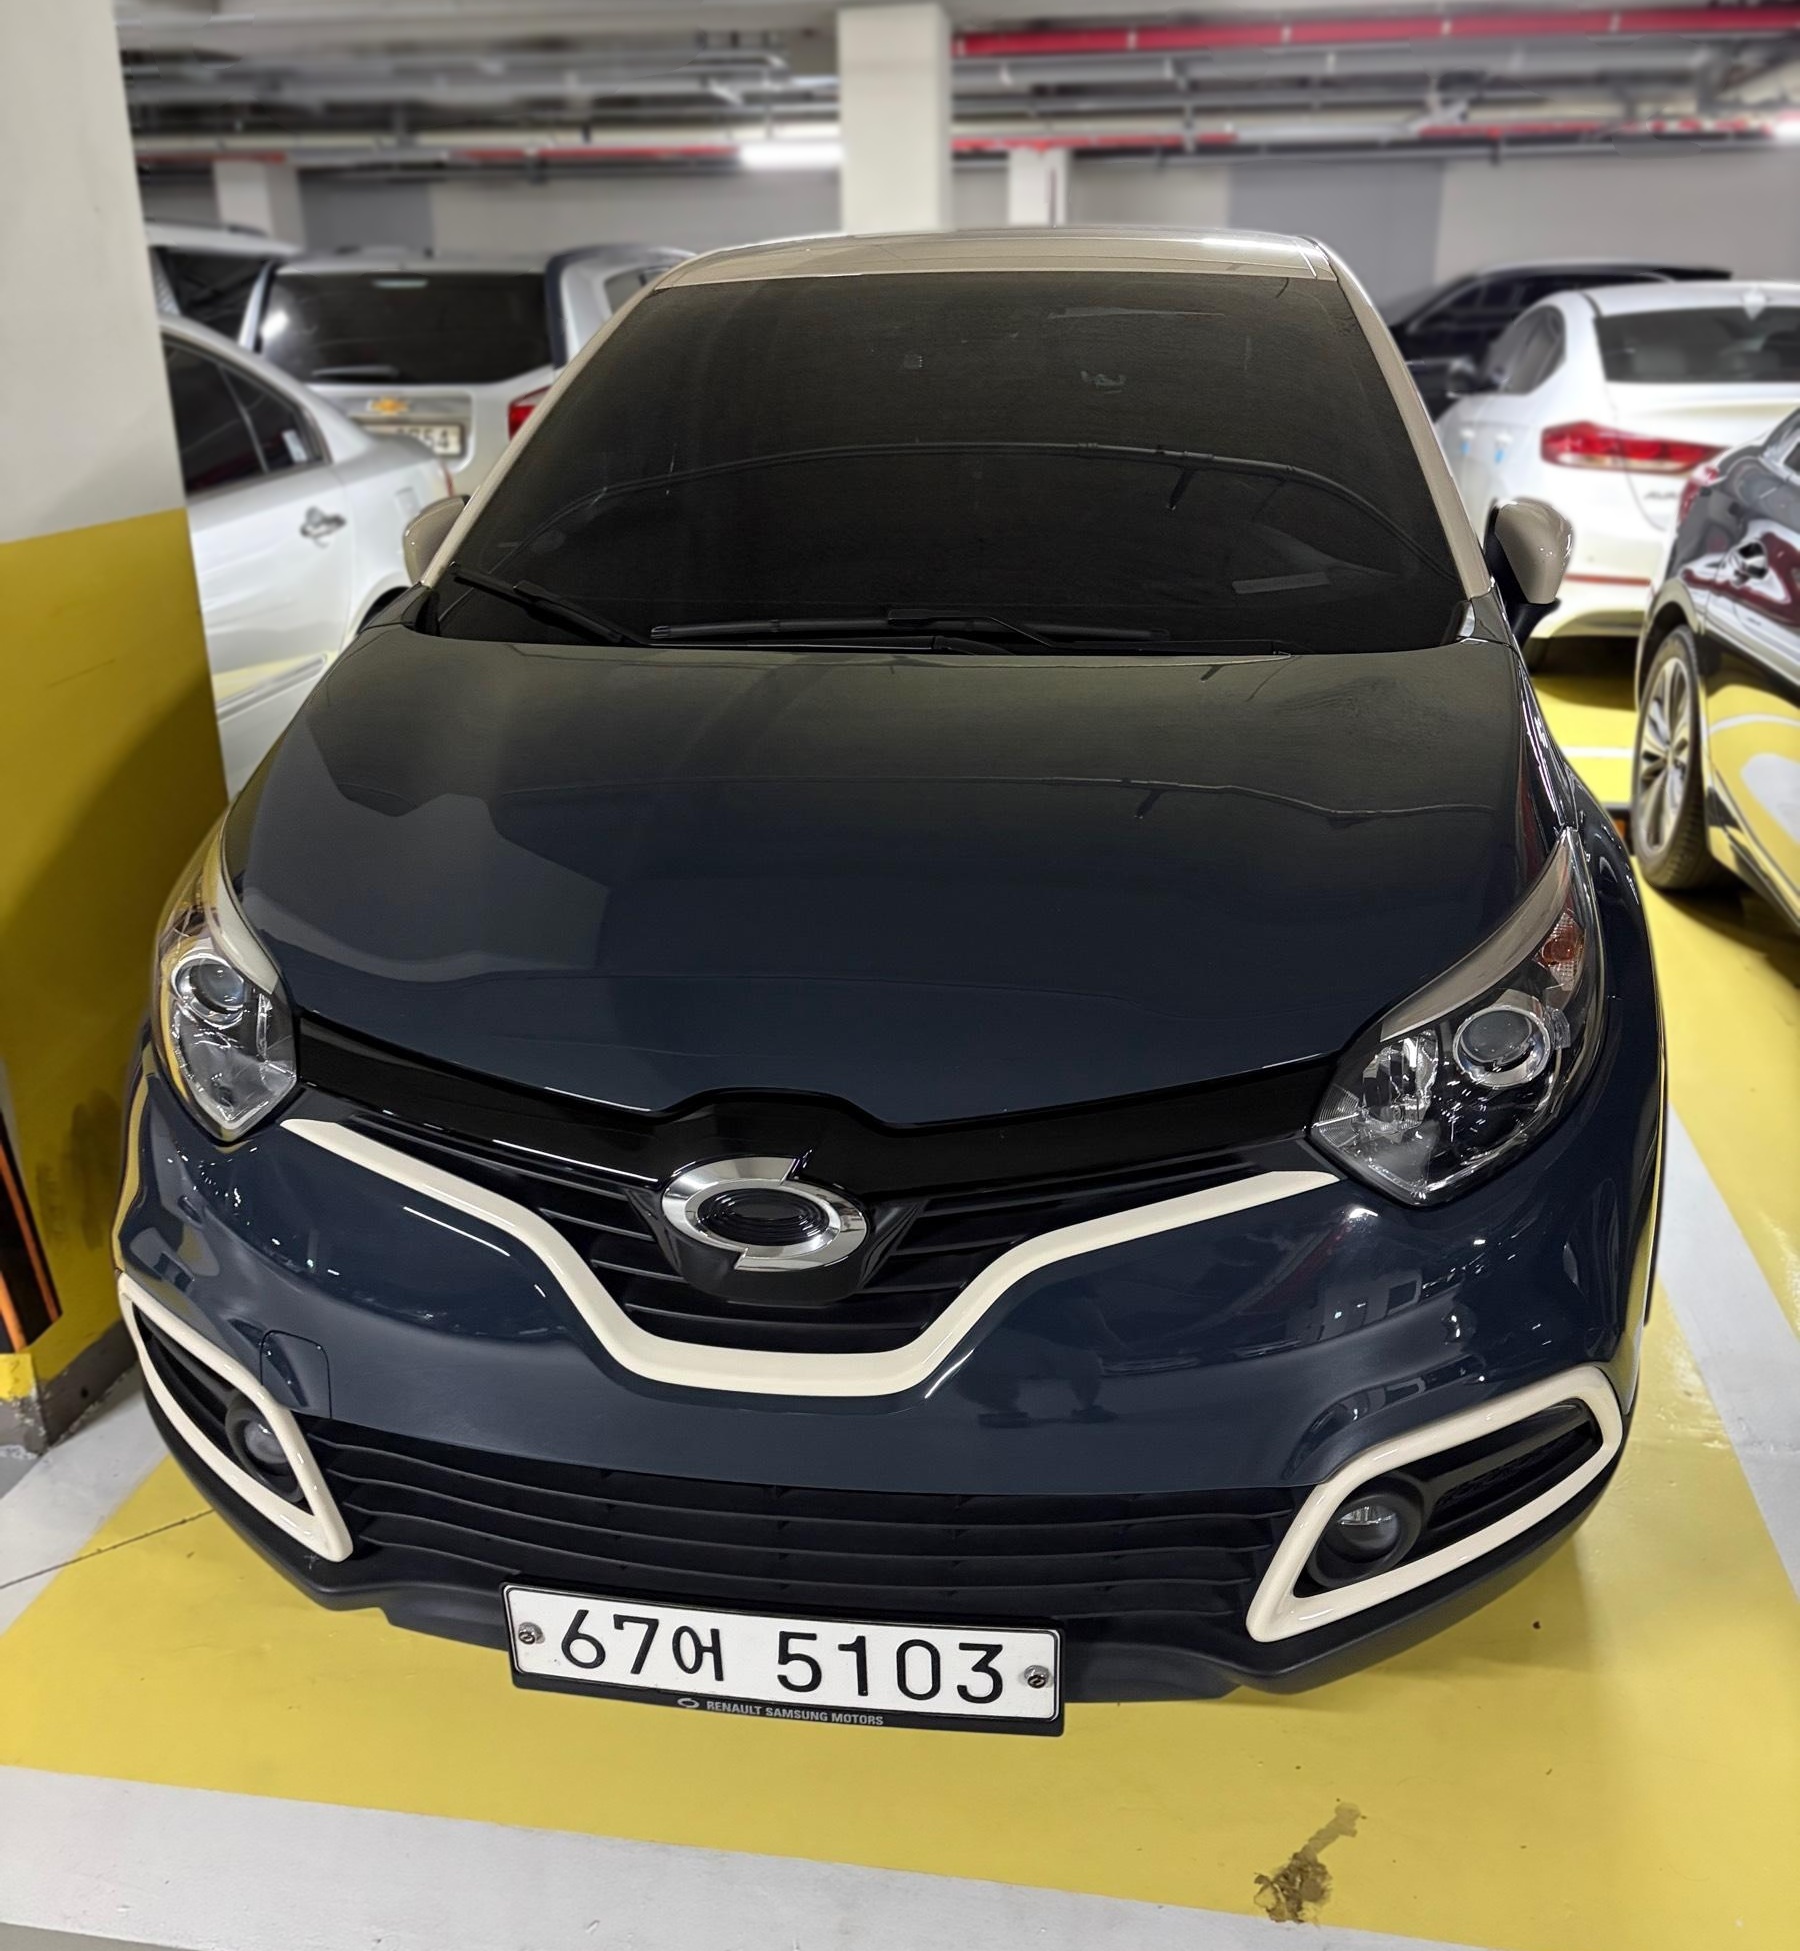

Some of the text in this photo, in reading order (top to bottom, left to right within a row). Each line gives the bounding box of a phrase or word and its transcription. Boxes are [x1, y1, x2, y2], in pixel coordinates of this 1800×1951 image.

[560, 1608, 1004, 1705] 67어 5103
[706, 1701, 884, 1726] RENAULT SAMSUNG MOTORS
